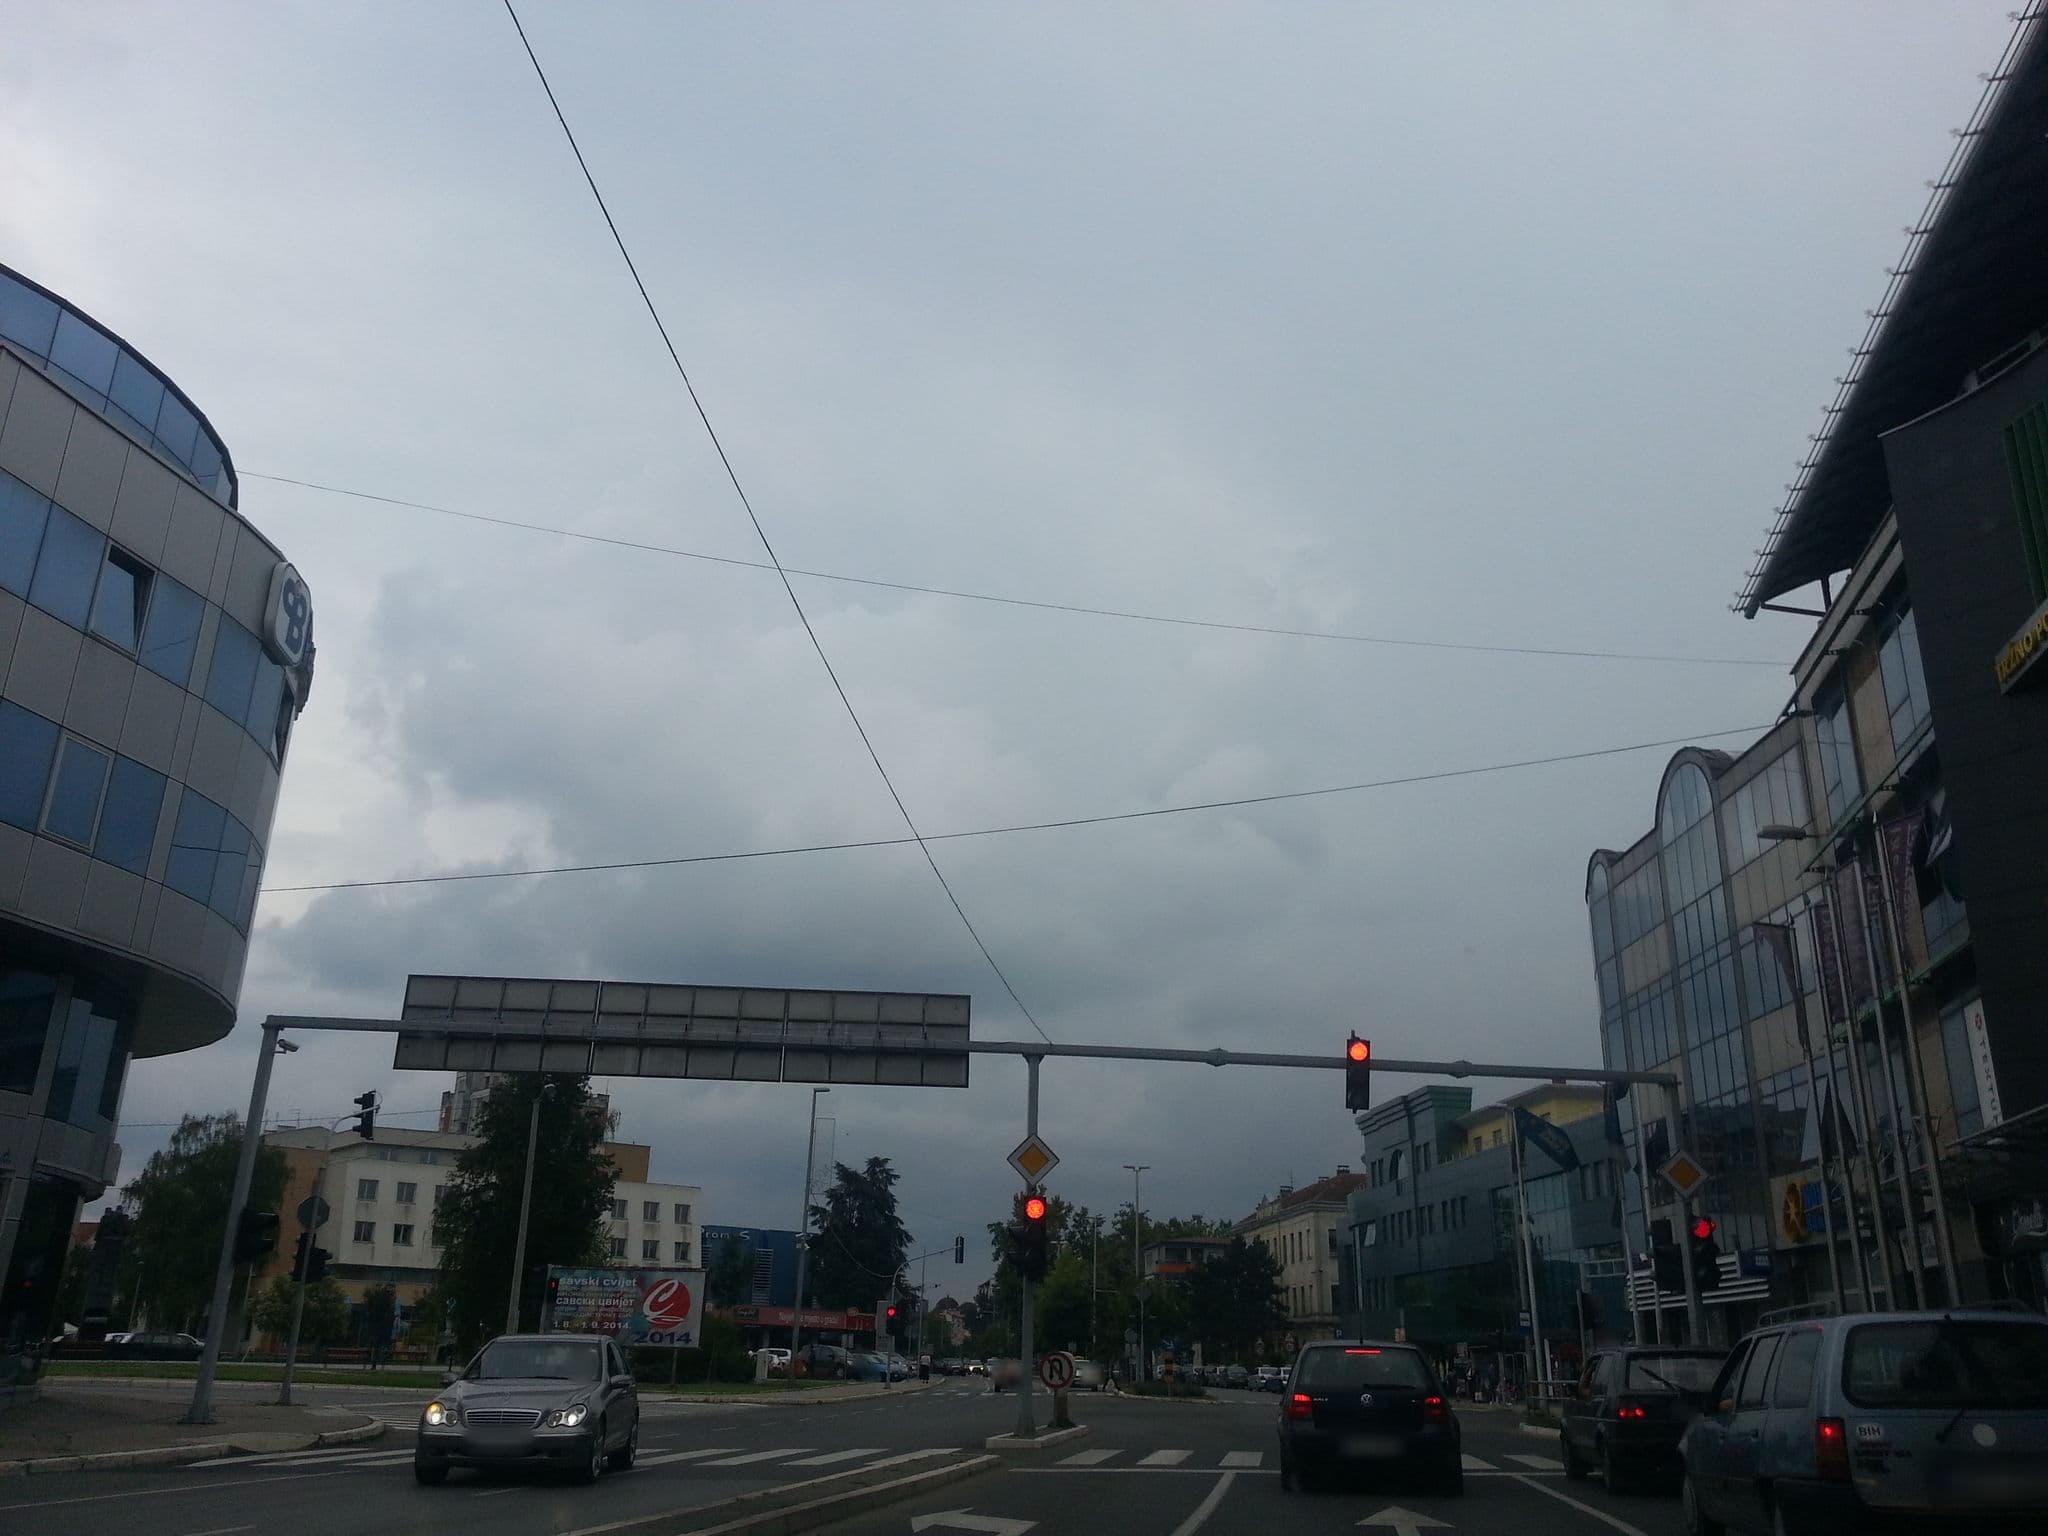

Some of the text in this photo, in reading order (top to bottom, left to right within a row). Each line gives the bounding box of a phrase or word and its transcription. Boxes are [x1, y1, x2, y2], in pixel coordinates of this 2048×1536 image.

[602, 1277, 638, 1288] cvijet
[555, 1296, 635, 1308] савски цвијет
[633, 1331, 692, 1345] 2014
